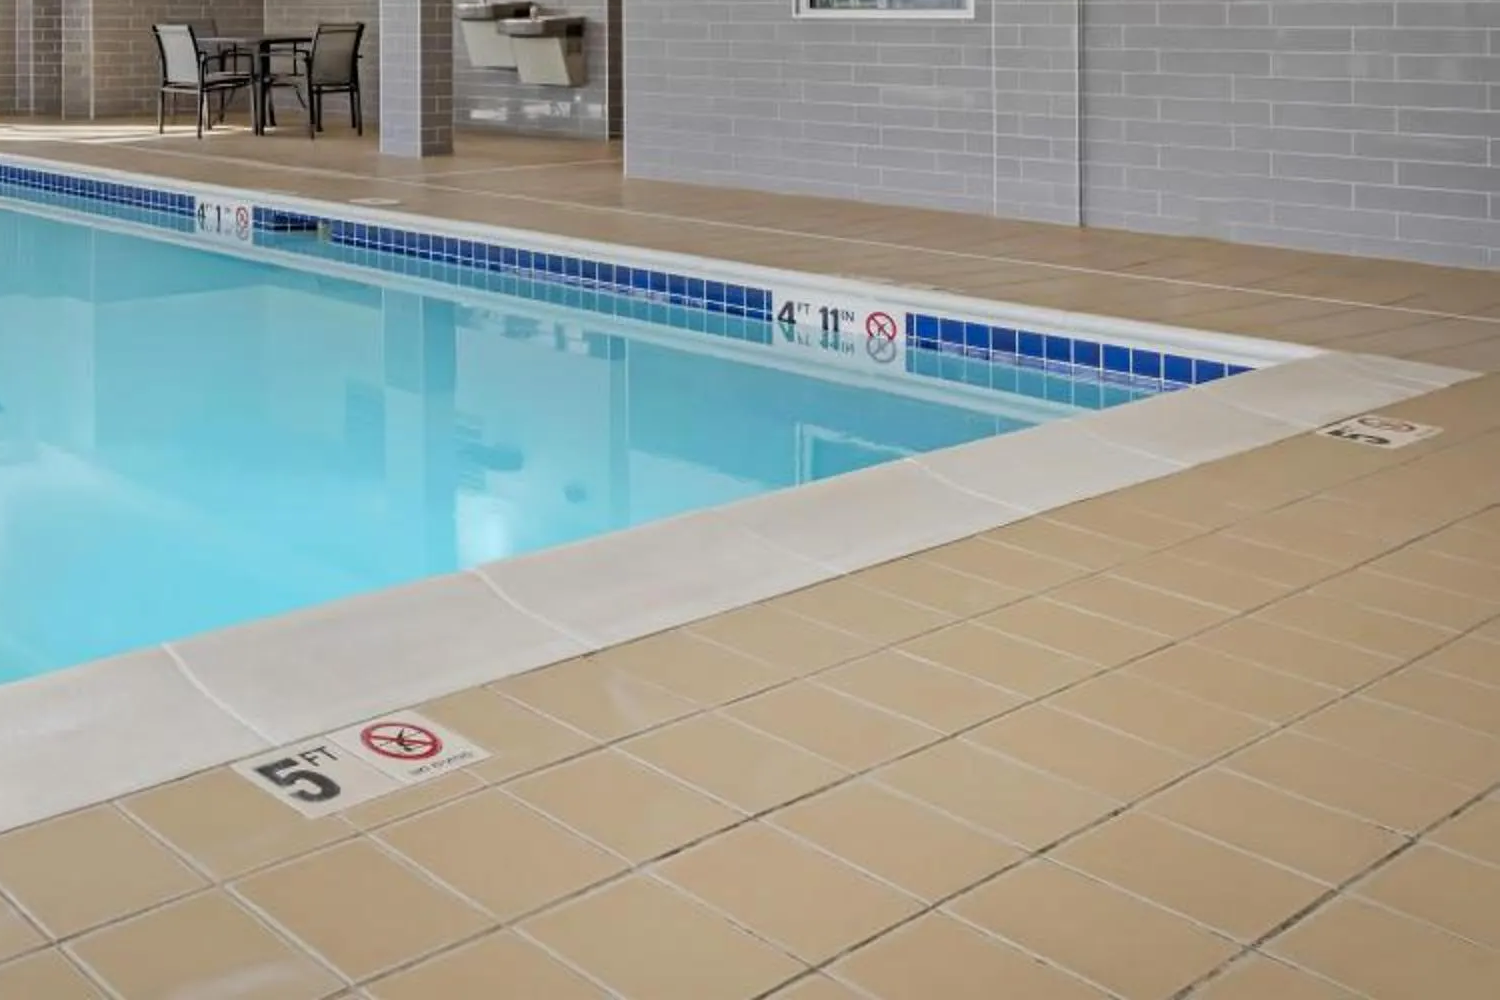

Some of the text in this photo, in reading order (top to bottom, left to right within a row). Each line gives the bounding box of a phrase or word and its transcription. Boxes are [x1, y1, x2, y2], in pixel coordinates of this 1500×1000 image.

[778, 300, 796, 324] 4
[819, 306, 840, 332] 11
[841, 310, 855, 322] IN
[255, 745, 341, 802] 5 FT
